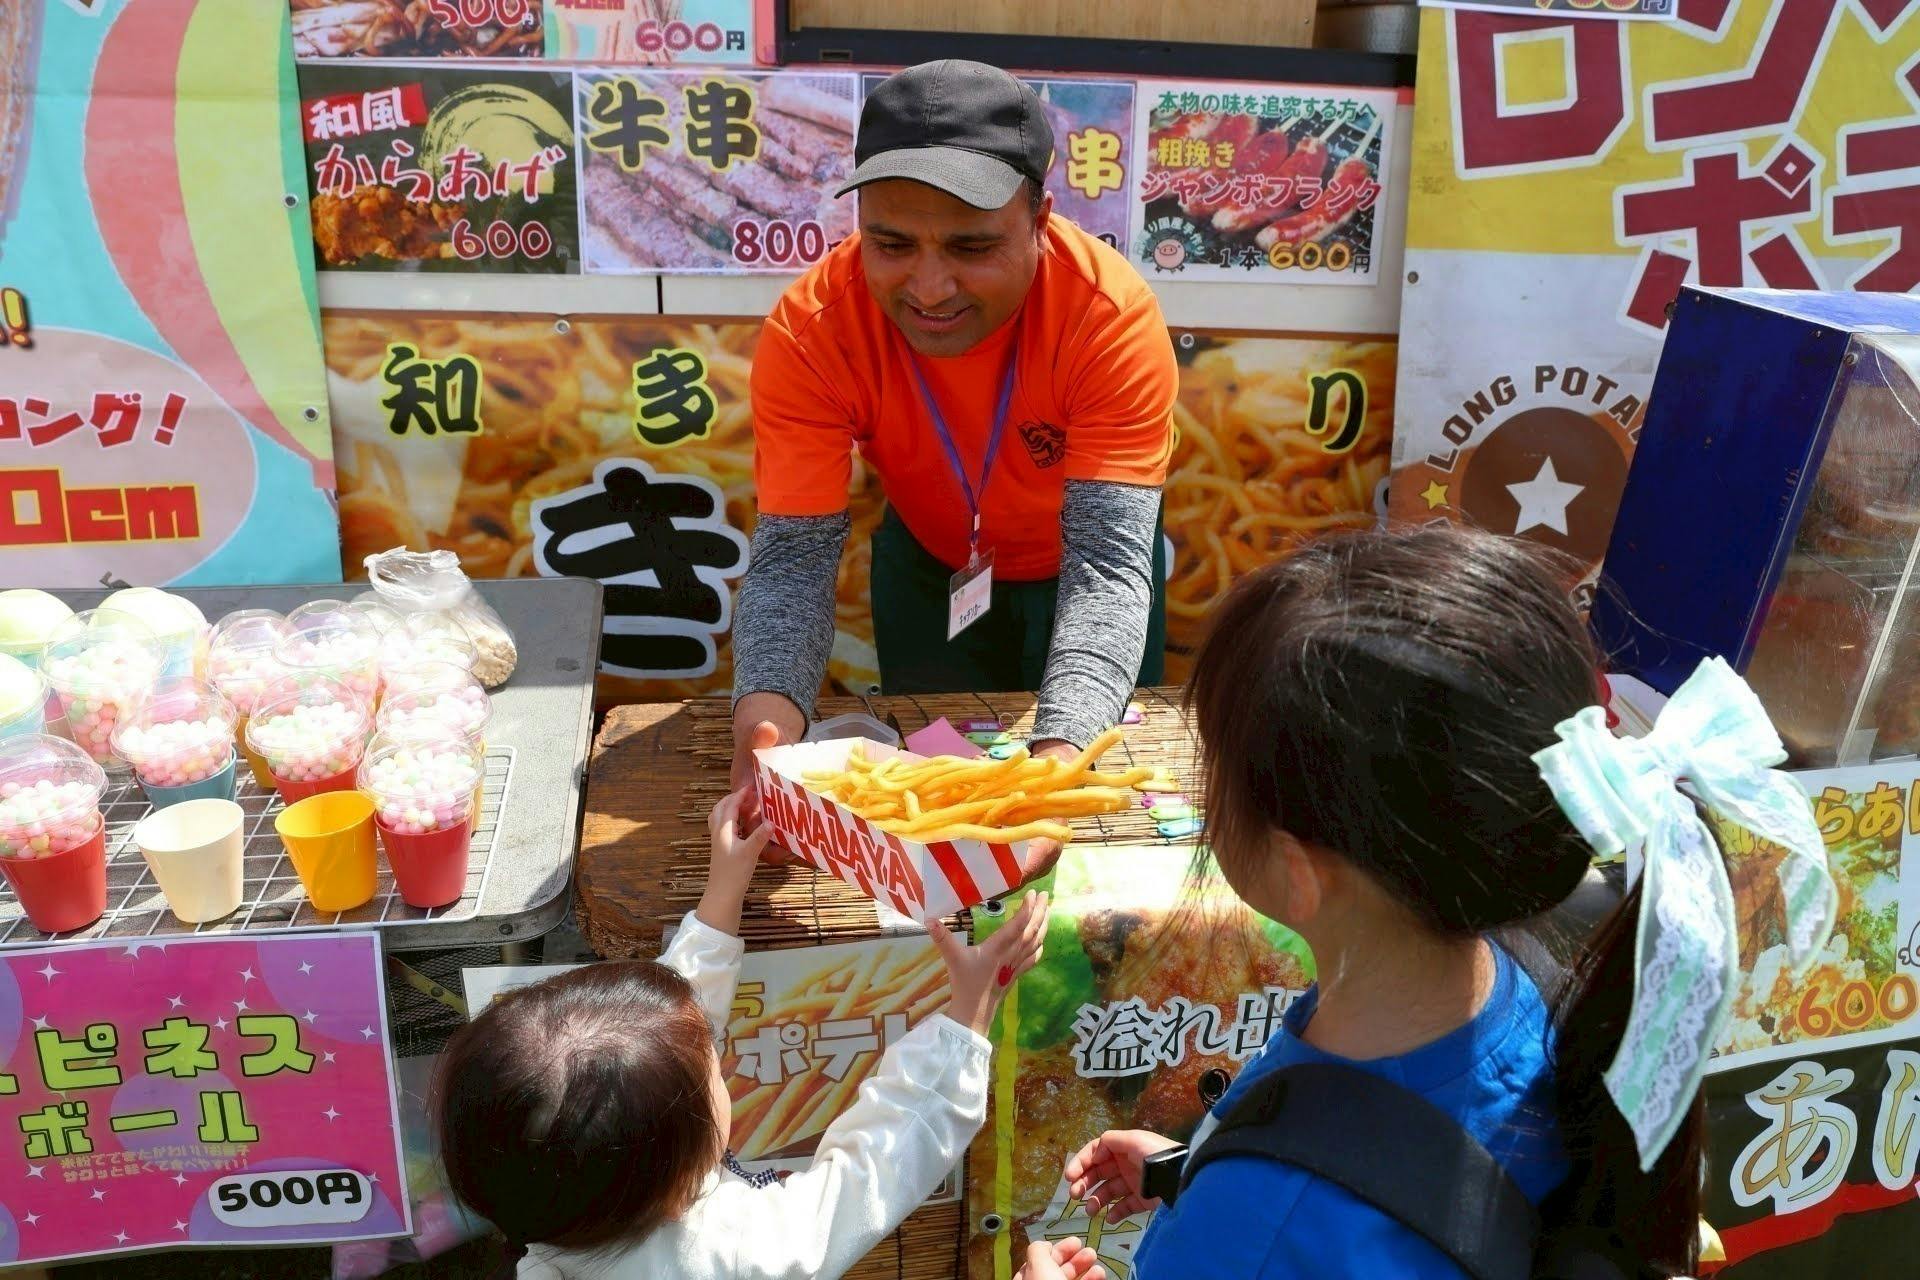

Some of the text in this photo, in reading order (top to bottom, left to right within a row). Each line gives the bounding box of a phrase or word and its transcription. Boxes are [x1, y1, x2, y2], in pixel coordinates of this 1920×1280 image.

[635, 20, 745, 51] 600円
[309, 87, 409, 141] 和風
[1158, 91, 1377, 121] 本物の味を追究する方へ
[1455, 0, 1920, 169] ロン
[587, 80, 761, 173] 牛串
[1157, 138, 1235, 168] 粗挽き
[315, 140, 566, 203] からあげ
[1047, 127, 1125, 200] 串
[1140, 171, 1382, 211] ジャンボフランク
[733, 220, 842, 264] 800
[1425, 365, 1642, 473] LONG POTA
[538, 464, 741, 671] き
[759, 776, 917, 902] HIMALAYA
[1814, 779, 1920, 846] らあ
[0, 1014, 316, 1095] ピネス
[720, 1011, 910, 1085] ポテ
[18, 1091, 260, 1159] ボール
[217, 1172, 362, 1212] 500円
